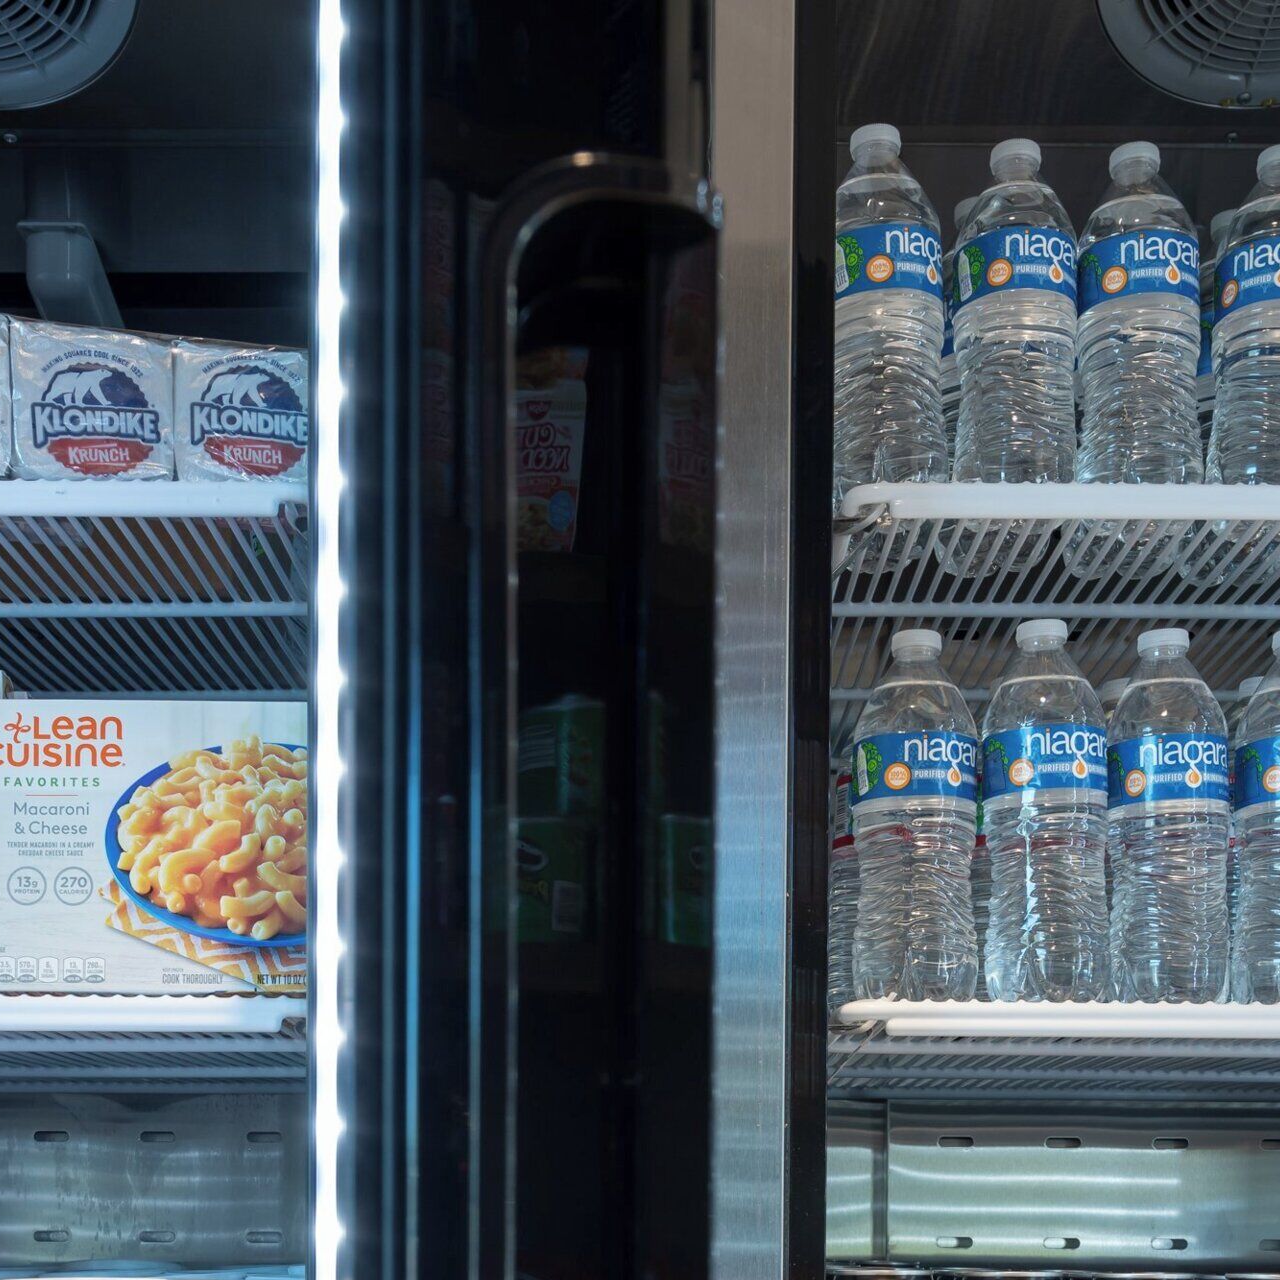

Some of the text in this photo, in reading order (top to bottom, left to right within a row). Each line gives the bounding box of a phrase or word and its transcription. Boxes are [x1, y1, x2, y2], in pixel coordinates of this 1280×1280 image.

[1241, 275, 1271, 288] PURIFIED
[33, 404, 159, 447] KLONDIKE
[69, 445, 130, 465] KRUNCH
[4, 776, 100, 787] FAVORITES
[13, 801, 90, 816] Macaroni
[14, 822, 88, 835] & Cheese
[17, 876, 38, 889] 13g
[60, 876, 87, 888] 270
